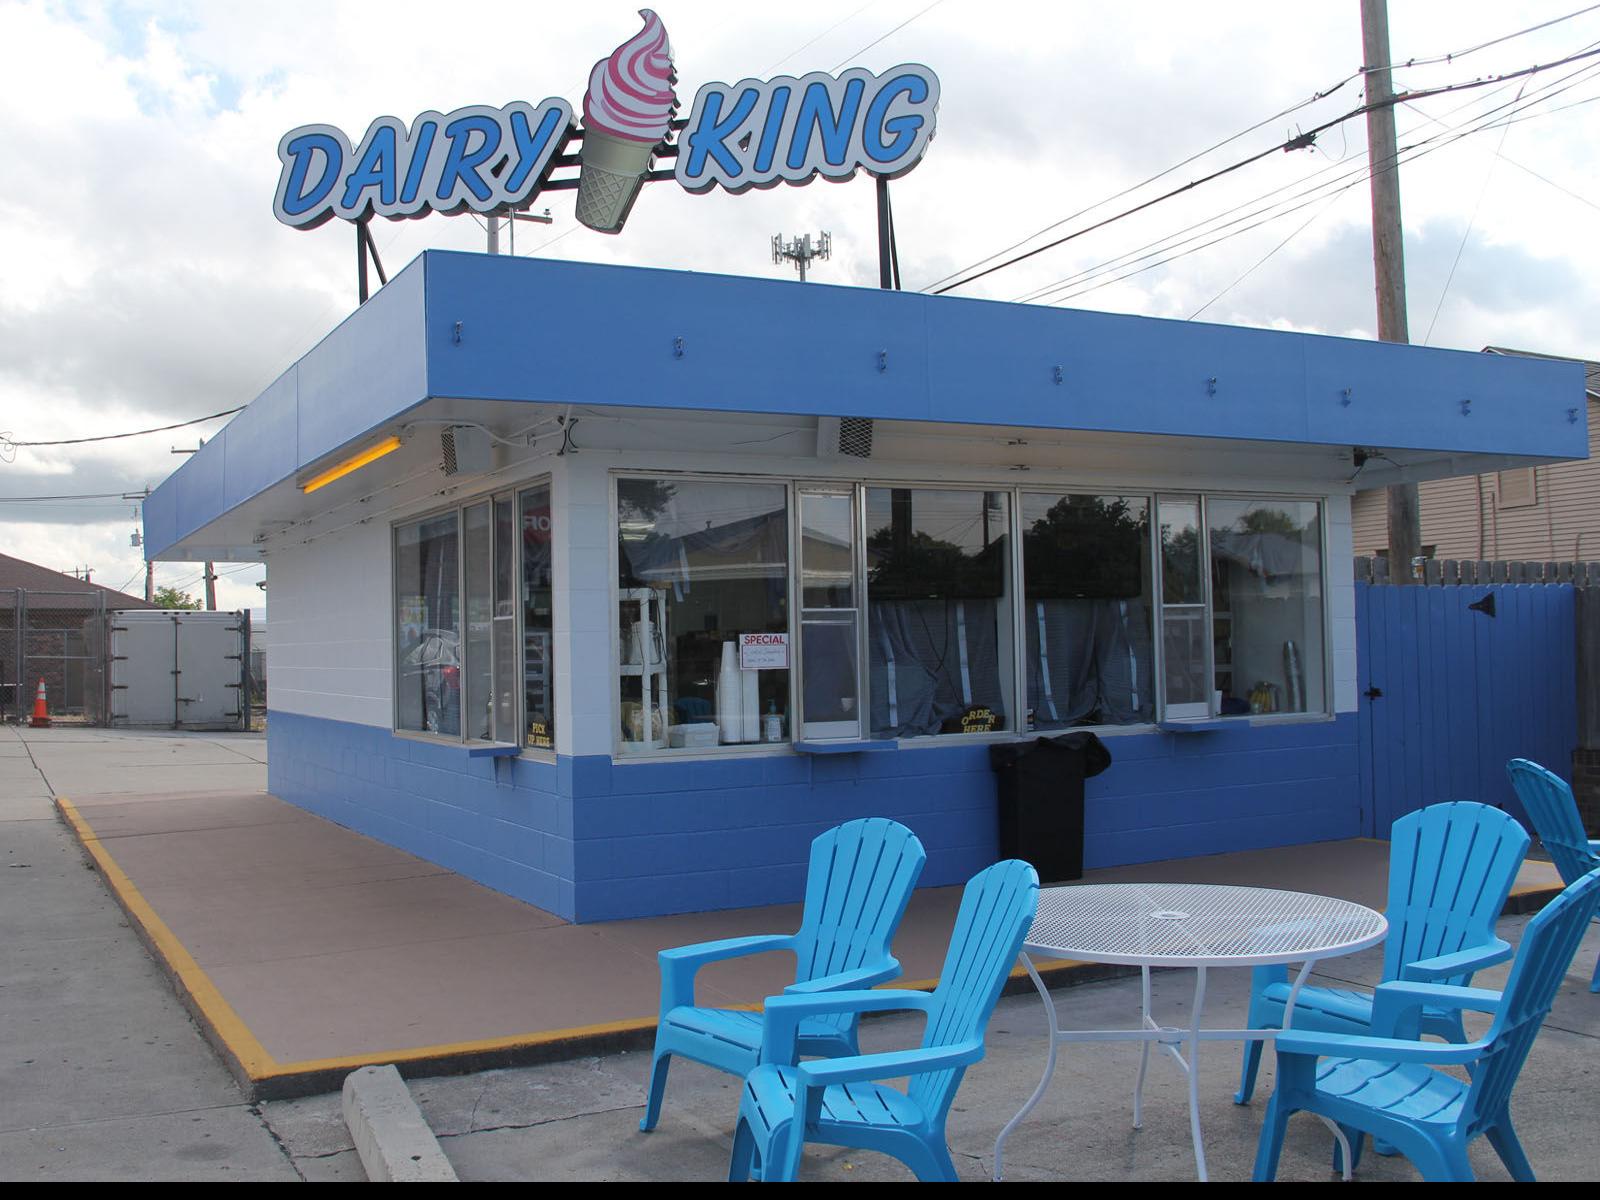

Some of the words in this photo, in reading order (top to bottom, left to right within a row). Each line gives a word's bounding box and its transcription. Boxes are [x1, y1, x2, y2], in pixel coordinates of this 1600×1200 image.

[282, 106, 564, 217] DAIRY
[684, 73, 930, 179] KING
[744, 635, 785, 645] SPECIAL
[961, 709, 996, 725] ORDER
[532, 722, 546, 735] PICK
[963, 725, 992, 734] HERE
[527, 734, 535, 745] UP
